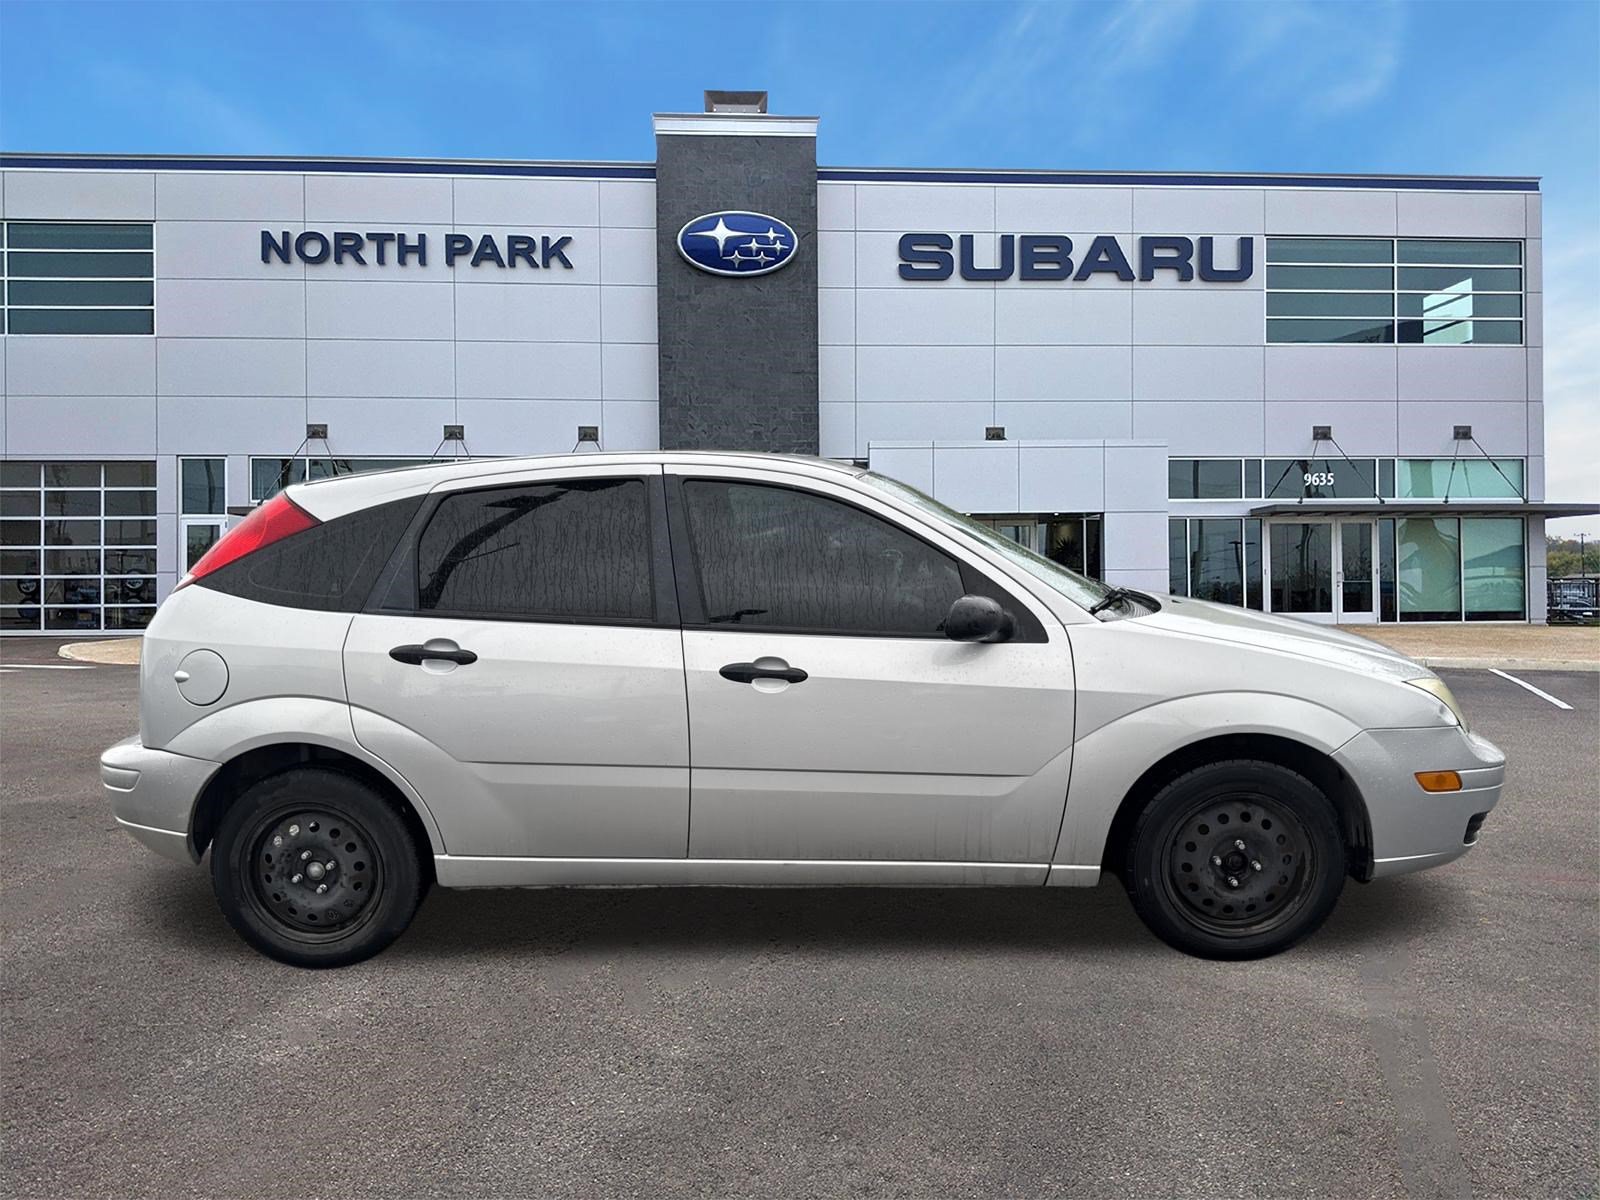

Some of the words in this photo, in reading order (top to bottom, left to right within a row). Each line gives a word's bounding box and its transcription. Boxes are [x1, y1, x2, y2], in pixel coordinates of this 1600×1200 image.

[261, 230, 427, 267] NORTH
[444, 233, 574, 270] PARK
[898, 233, 1255, 283] SUBARU
[1303, 472, 1335, 486] 9635
